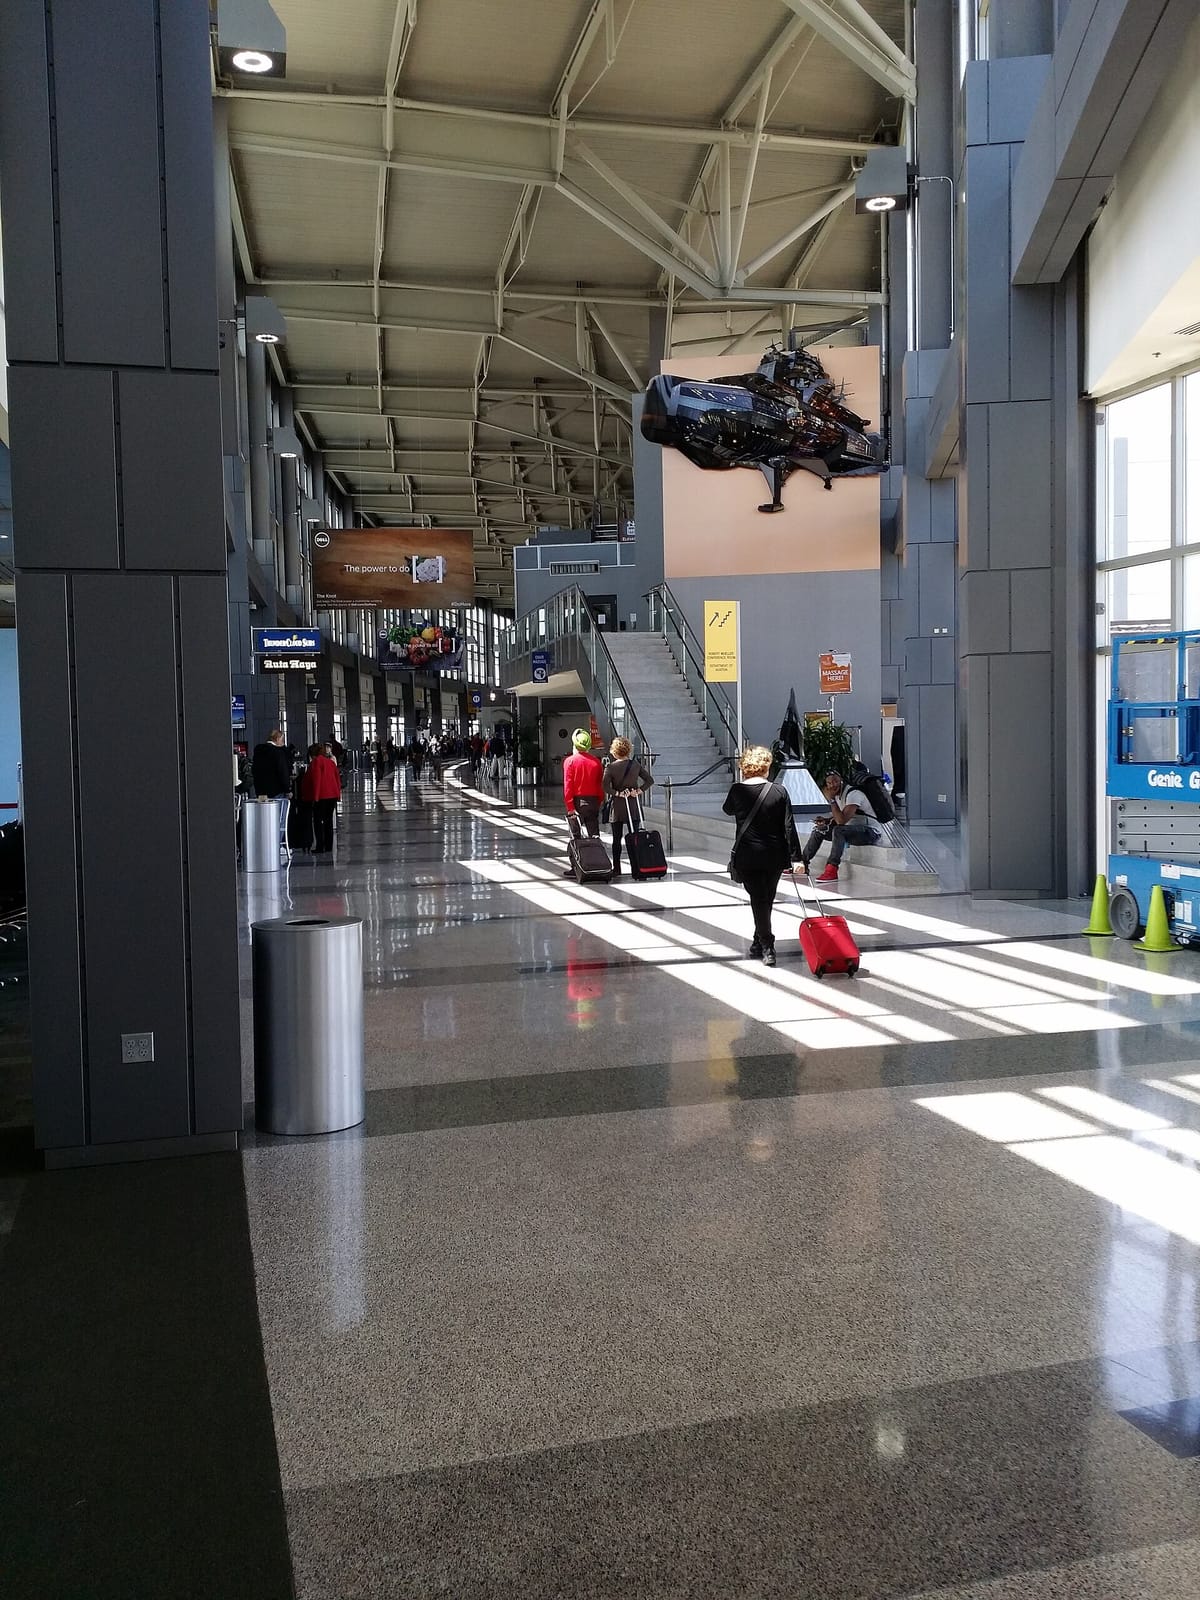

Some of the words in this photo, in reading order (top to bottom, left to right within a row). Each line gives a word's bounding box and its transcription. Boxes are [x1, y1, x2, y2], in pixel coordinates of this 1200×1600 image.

[344, 564, 360, 573] The
[361, 566, 387, 575] power
[389, 565, 398, 573] to
[399, 564, 410, 573] do
[312, 688, 320, 699] 7
[1147, 769, 1184, 788] Genie
